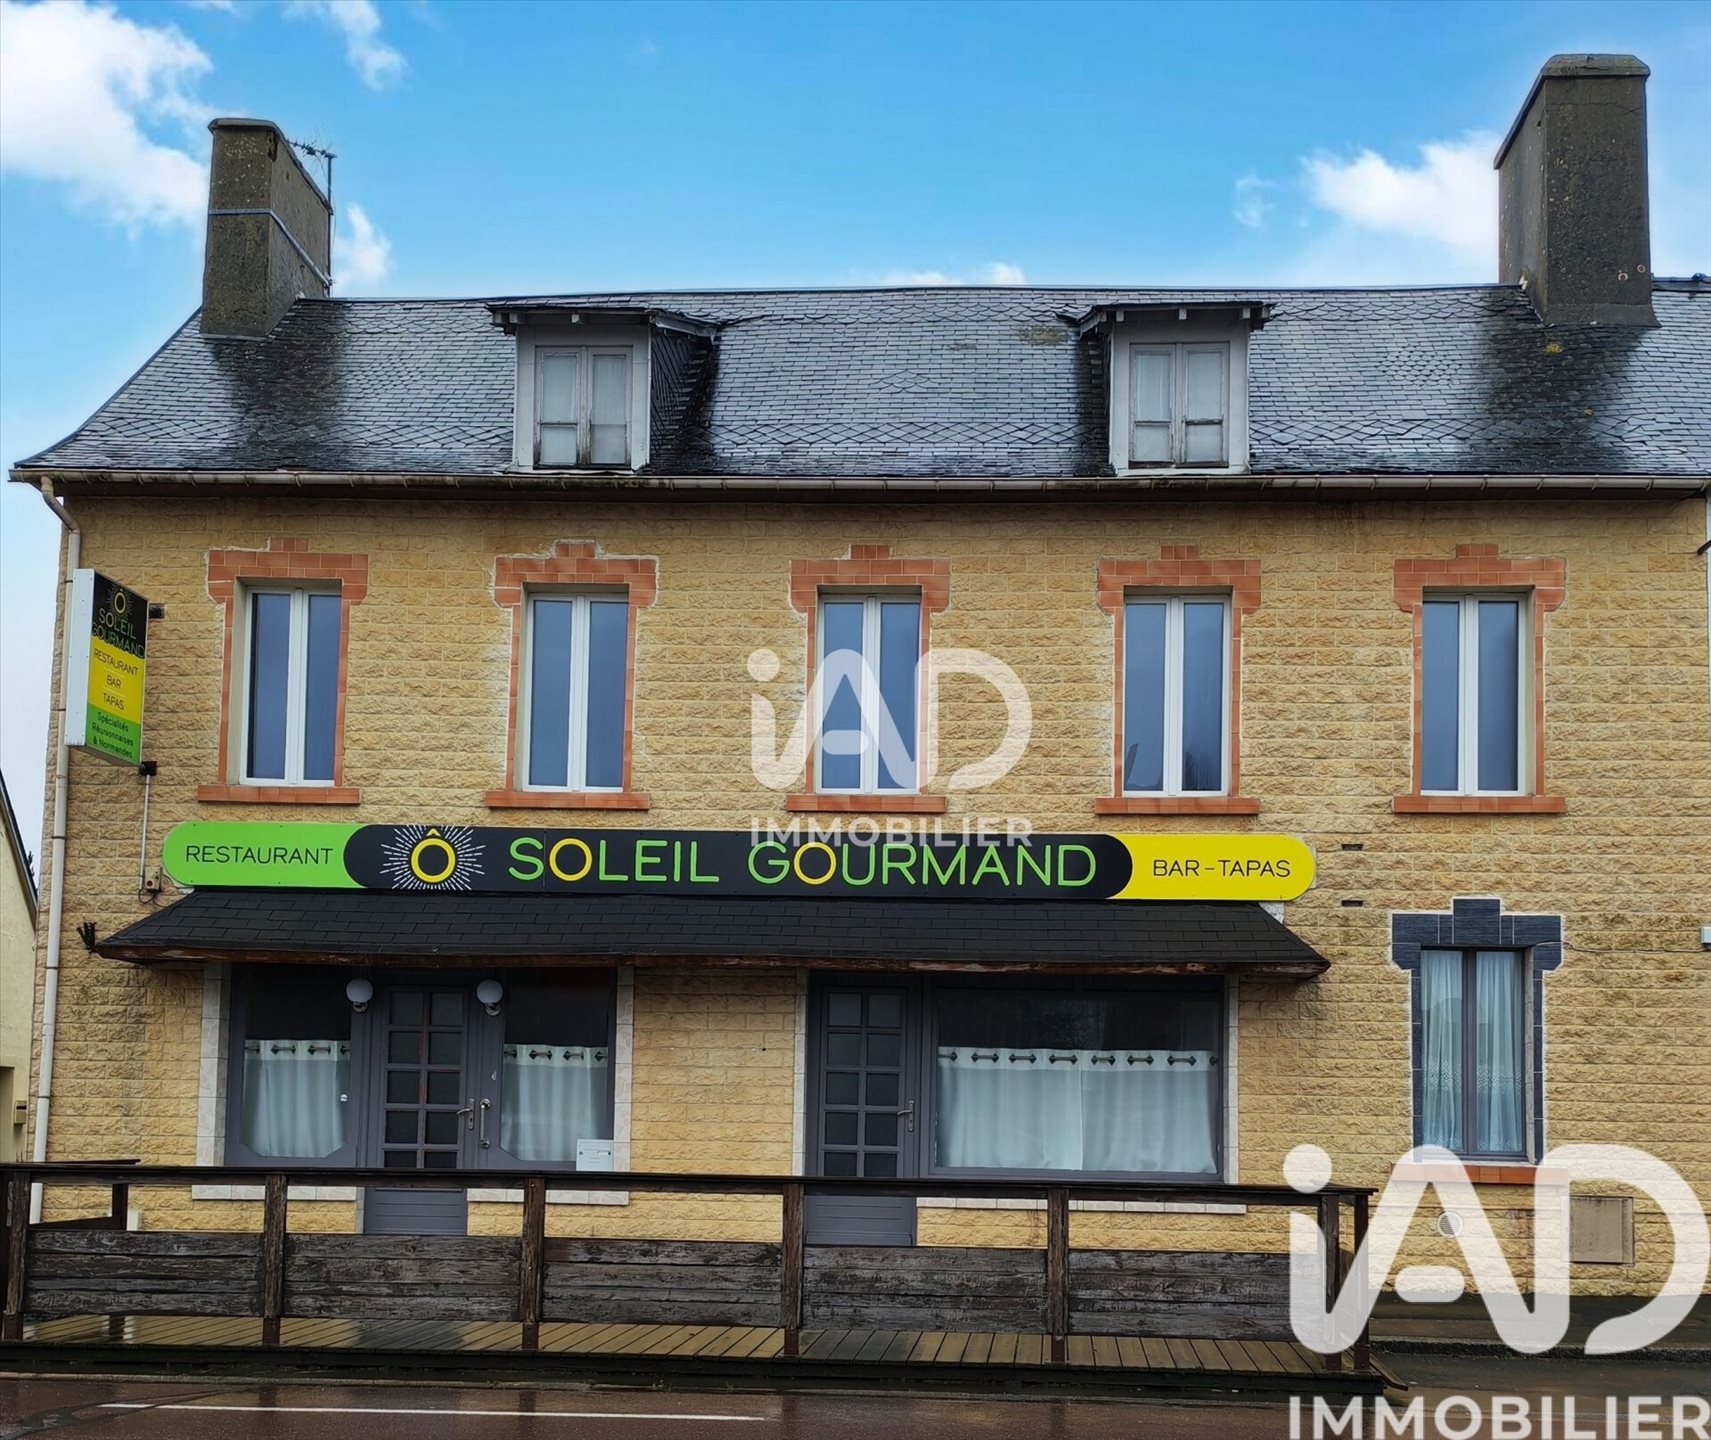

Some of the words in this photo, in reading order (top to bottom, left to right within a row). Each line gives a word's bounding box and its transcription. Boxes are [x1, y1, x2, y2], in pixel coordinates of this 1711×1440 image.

[99, 607, 136, 640] SOLEIL
[92, 622, 145, 658] GOURMAND
[94, 650, 139, 676] RESTAURANT
[106, 674, 122, 689] BAR
[103, 692, 125, 711] TAPAS
[97, 711, 129, 732] Spécialités
[99, 737, 133, 759] Normandes
[186, 845, 333, 865] RESTAURANT
[508, 837, 720, 882] SOLEIL
[747, 841, 1097, 886] GOURMAND
